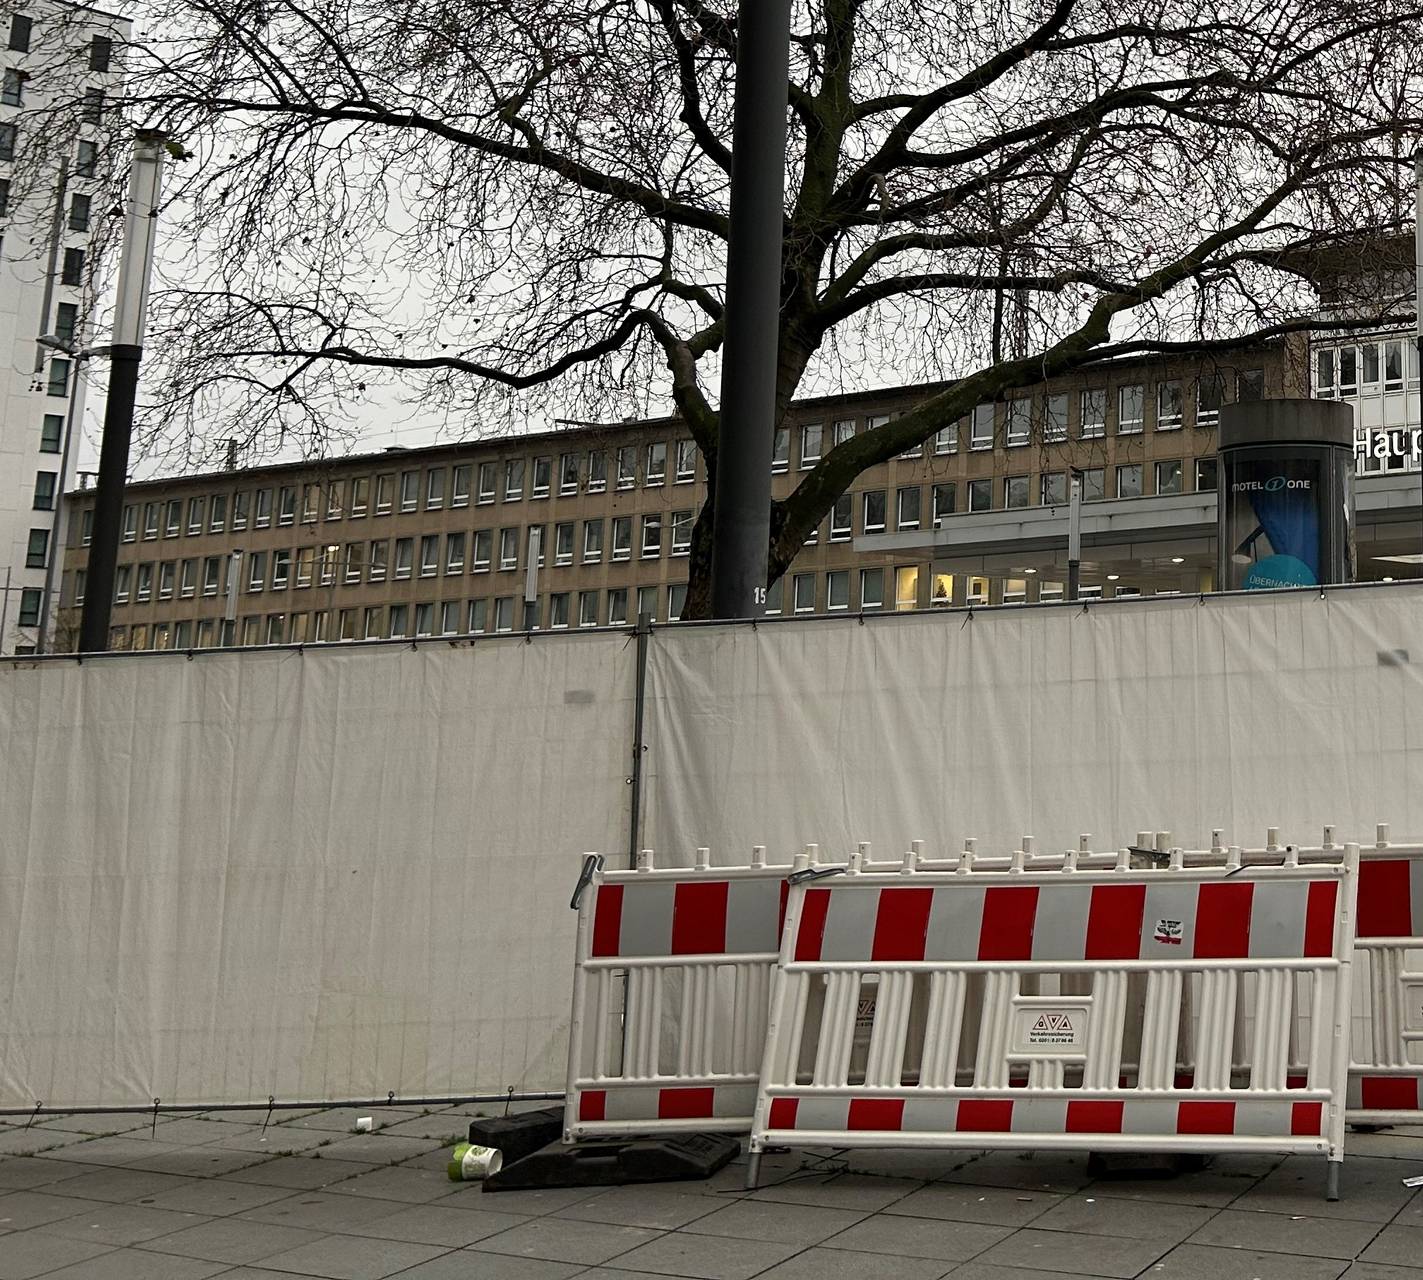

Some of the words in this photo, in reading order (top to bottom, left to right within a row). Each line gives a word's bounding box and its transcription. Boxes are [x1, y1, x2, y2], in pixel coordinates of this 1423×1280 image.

[1231, 481, 1263, 492] MOTEL
[1286, 480, 1311, 489] ONE
[754, 586, 766, 604] 15
